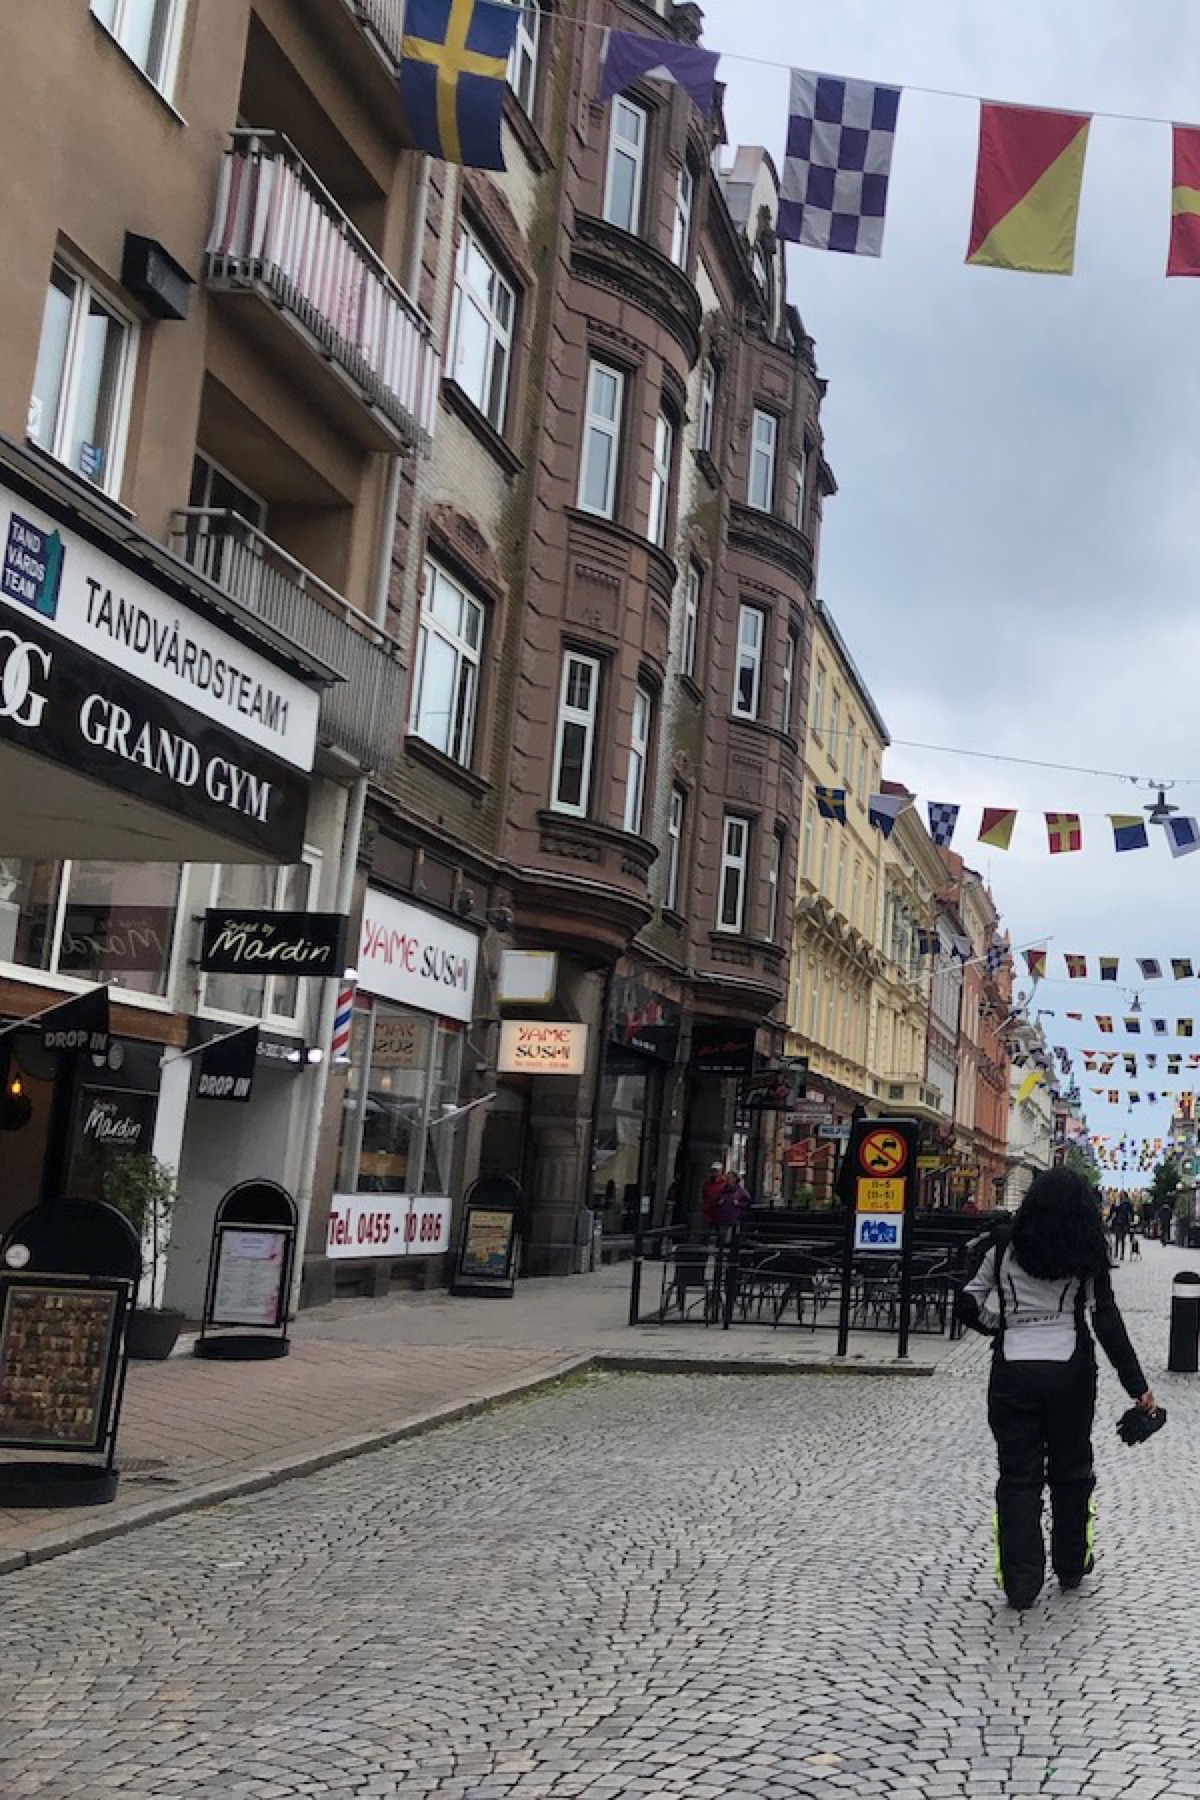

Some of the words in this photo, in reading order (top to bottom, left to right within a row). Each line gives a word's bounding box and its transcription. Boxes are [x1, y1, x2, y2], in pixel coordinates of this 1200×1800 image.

[5, 567, 36, 600] TEAM
[86, 576, 289, 736] TANDVÅRDSTEAM1
[80, 694, 200, 787] GRAND
[205, 757, 272, 823] GYM
[208, 932, 331, 962] Mardin
[363, 919, 419, 973] YAME
[419, 945, 470, 993] SUSHI
[44, 1030, 89, 1049] DROP
[89, 1031, 108, 1051] IN
[518, 1027, 572, 1043] YAME
[515, 1044, 571, 1060] SUSHI
[198, 1073, 235, 1096] DROP
[233, 1077, 251, 1097] IN
[83, 1108, 142, 1139] Mardin
[357, 1211, 391, 1244] 0455
